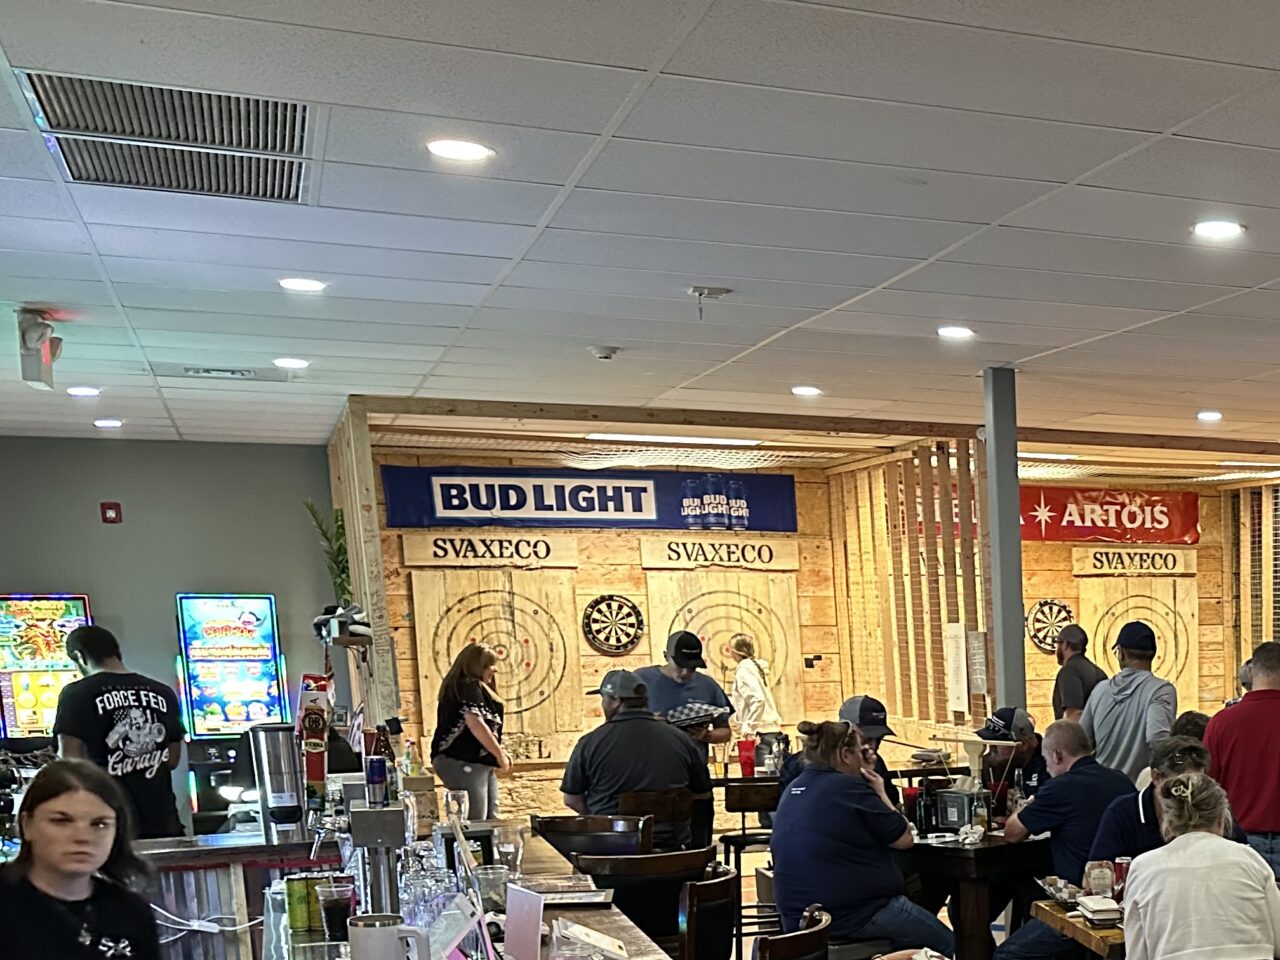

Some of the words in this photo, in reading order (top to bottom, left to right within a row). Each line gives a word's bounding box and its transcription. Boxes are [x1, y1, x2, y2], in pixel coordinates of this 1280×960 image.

[439, 483, 527, 513] BUD
[533, 485, 649, 514] LIGHT
[703, 495, 727, 505] BUD
[1060, 503, 1170, 530] ARTOIS
[433, 538, 552, 560] SVAXECO
[667, 542, 774, 565] SVAXECO
[1092, 551, 1177, 571] SVAXECO
[96, 690, 139, 717] FORCE
[140, 691, 167, 714] FED
[107, 746, 170, 779] Garage
